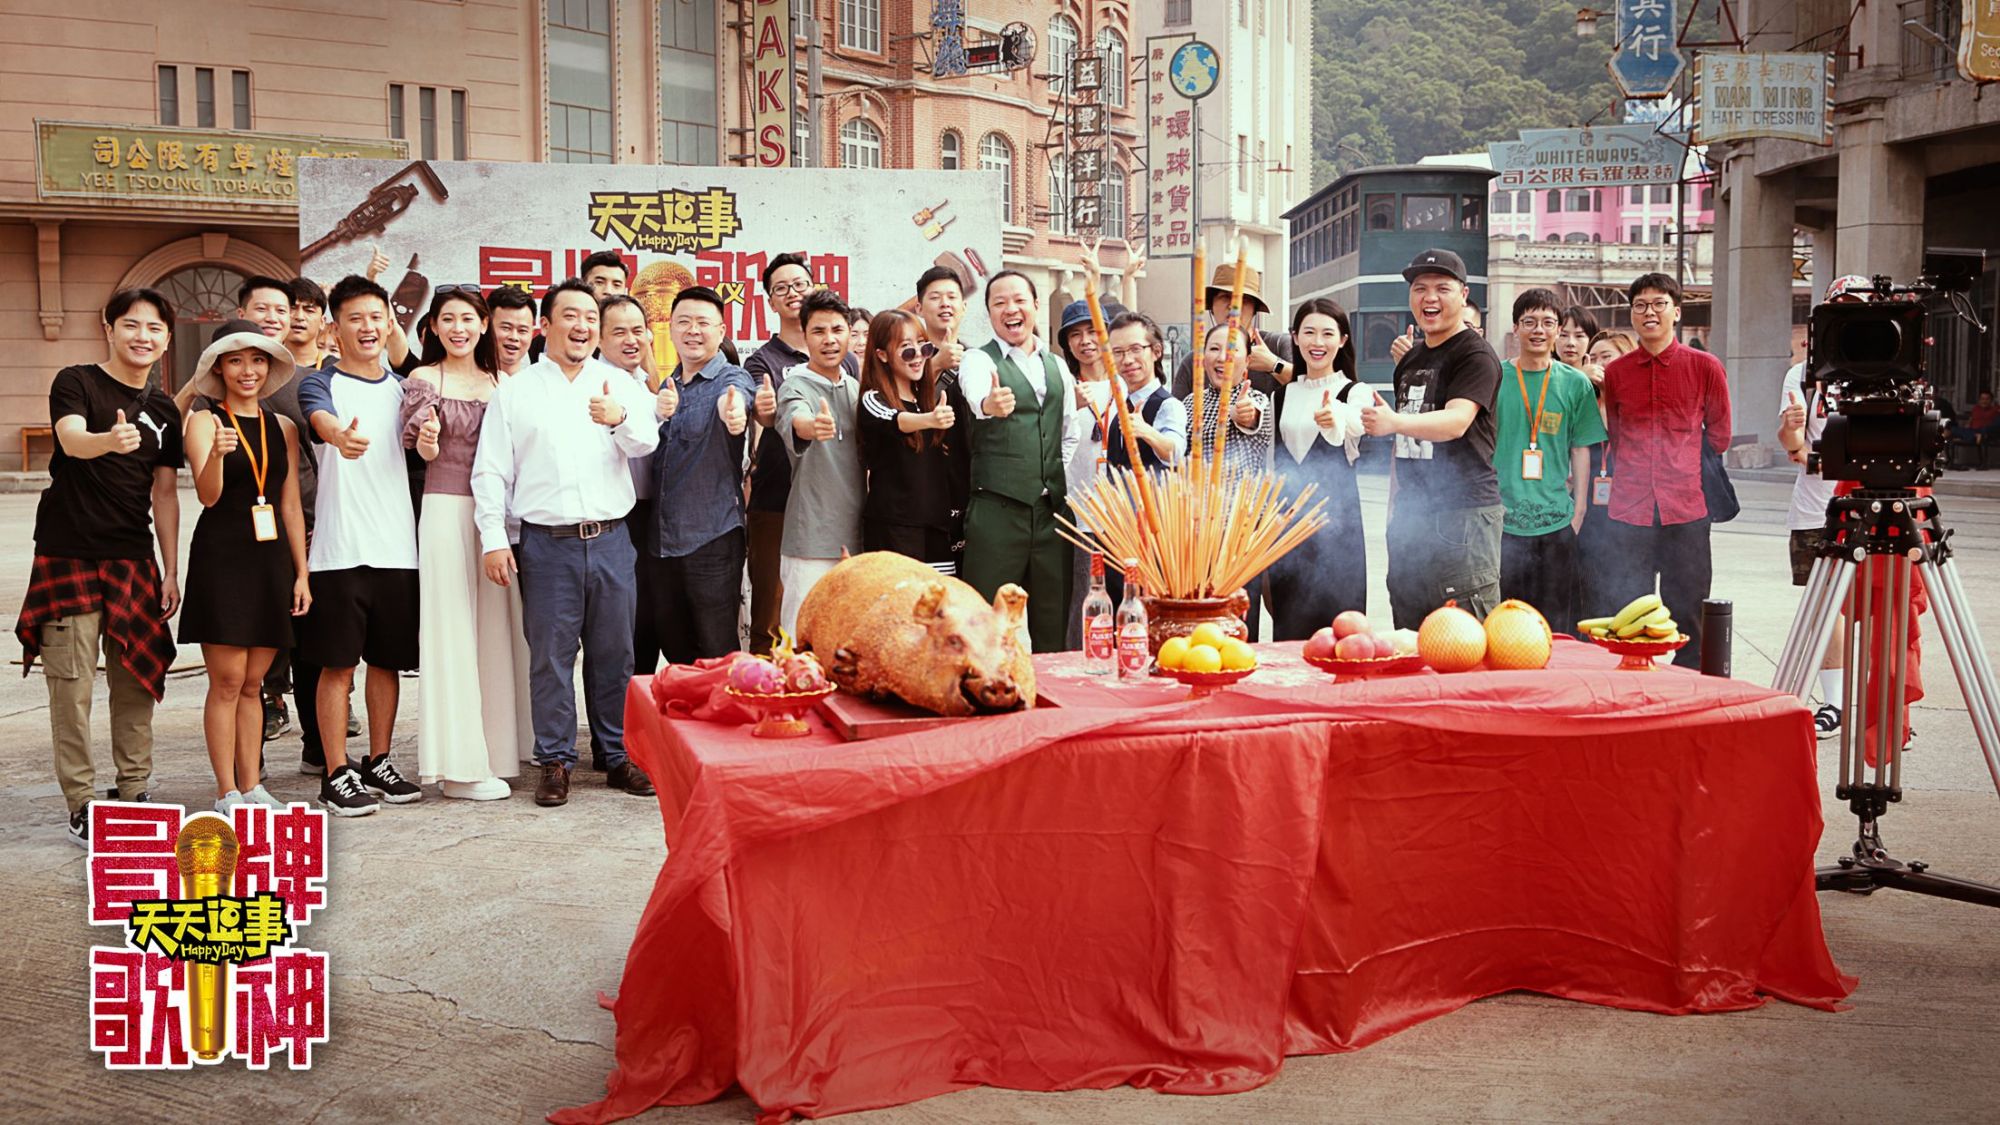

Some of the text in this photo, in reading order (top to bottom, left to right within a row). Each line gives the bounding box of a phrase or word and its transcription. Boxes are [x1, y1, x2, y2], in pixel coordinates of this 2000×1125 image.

[756, 0, 786, 168] AKS
[1714, 86, 1814, 109] MAN MING
[1712, 110, 1816, 126] HAIR DRESSING
[1535, 147, 1640, 166] WHITEAWAYS
[80, 172, 295, 197] YEE TSOONG TOBACCO
